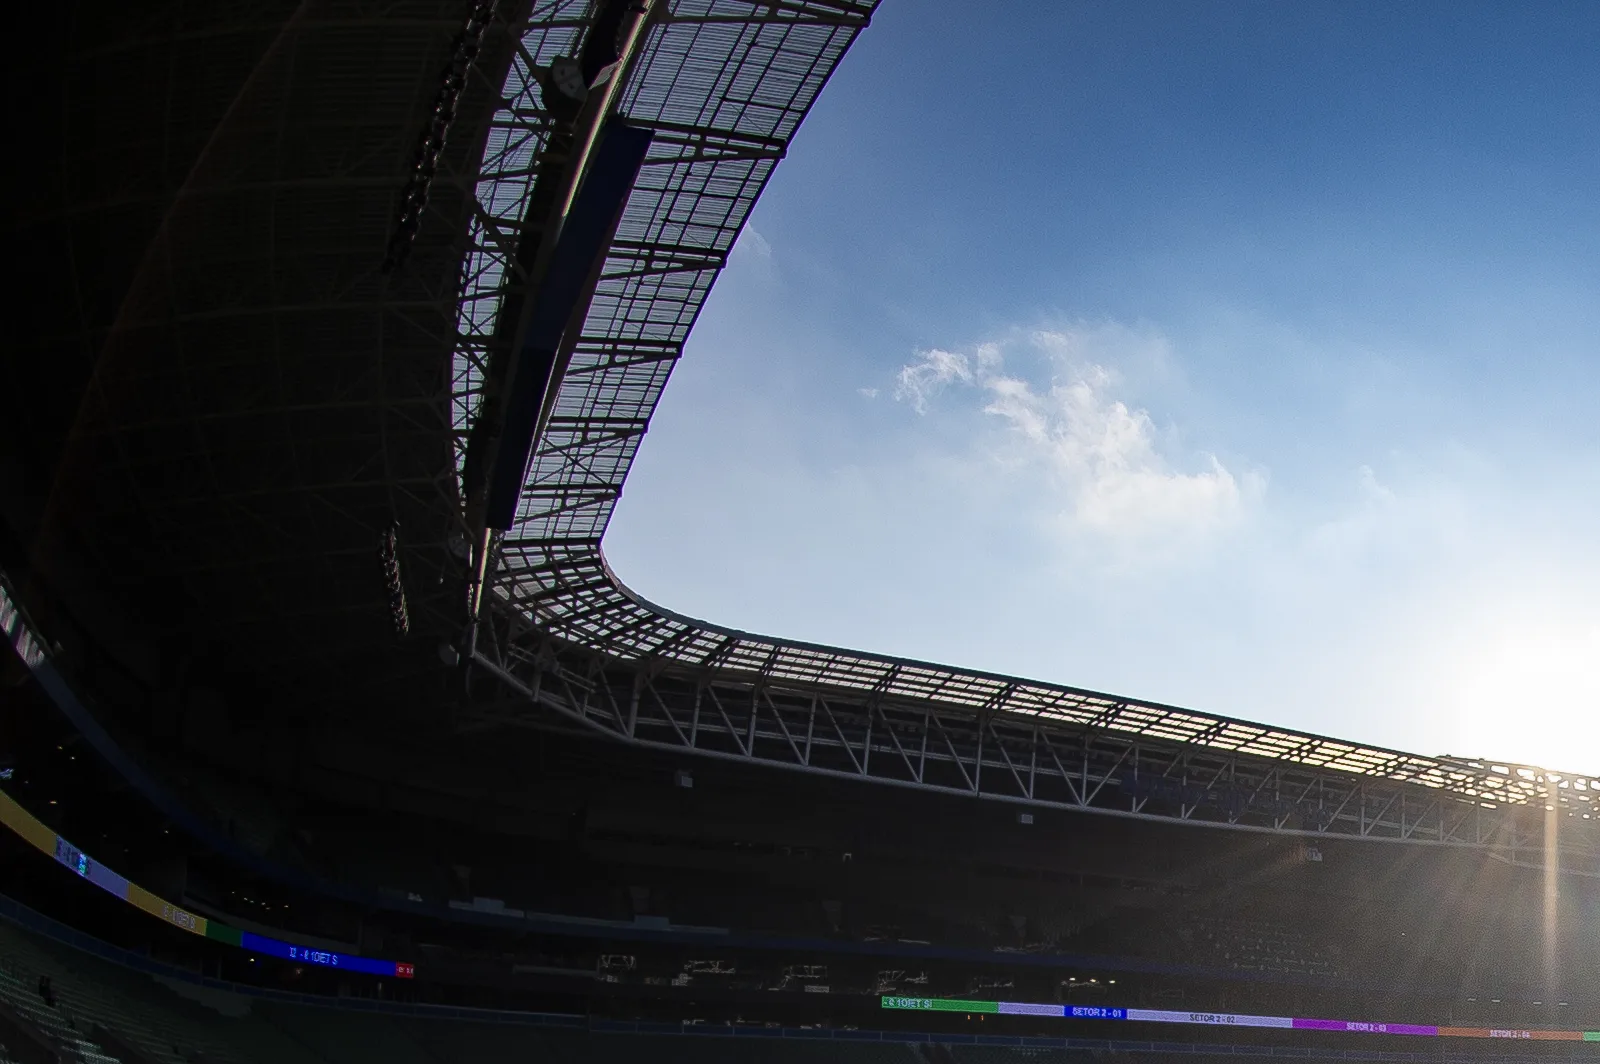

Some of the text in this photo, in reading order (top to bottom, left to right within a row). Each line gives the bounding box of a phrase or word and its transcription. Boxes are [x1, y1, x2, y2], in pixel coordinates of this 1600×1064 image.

[1072, 1006, 1100, 1016] SETOR
[1189, 1013, 1215, 1022] SETOR
[1346, 1021, 1369, 1031] SETOR
